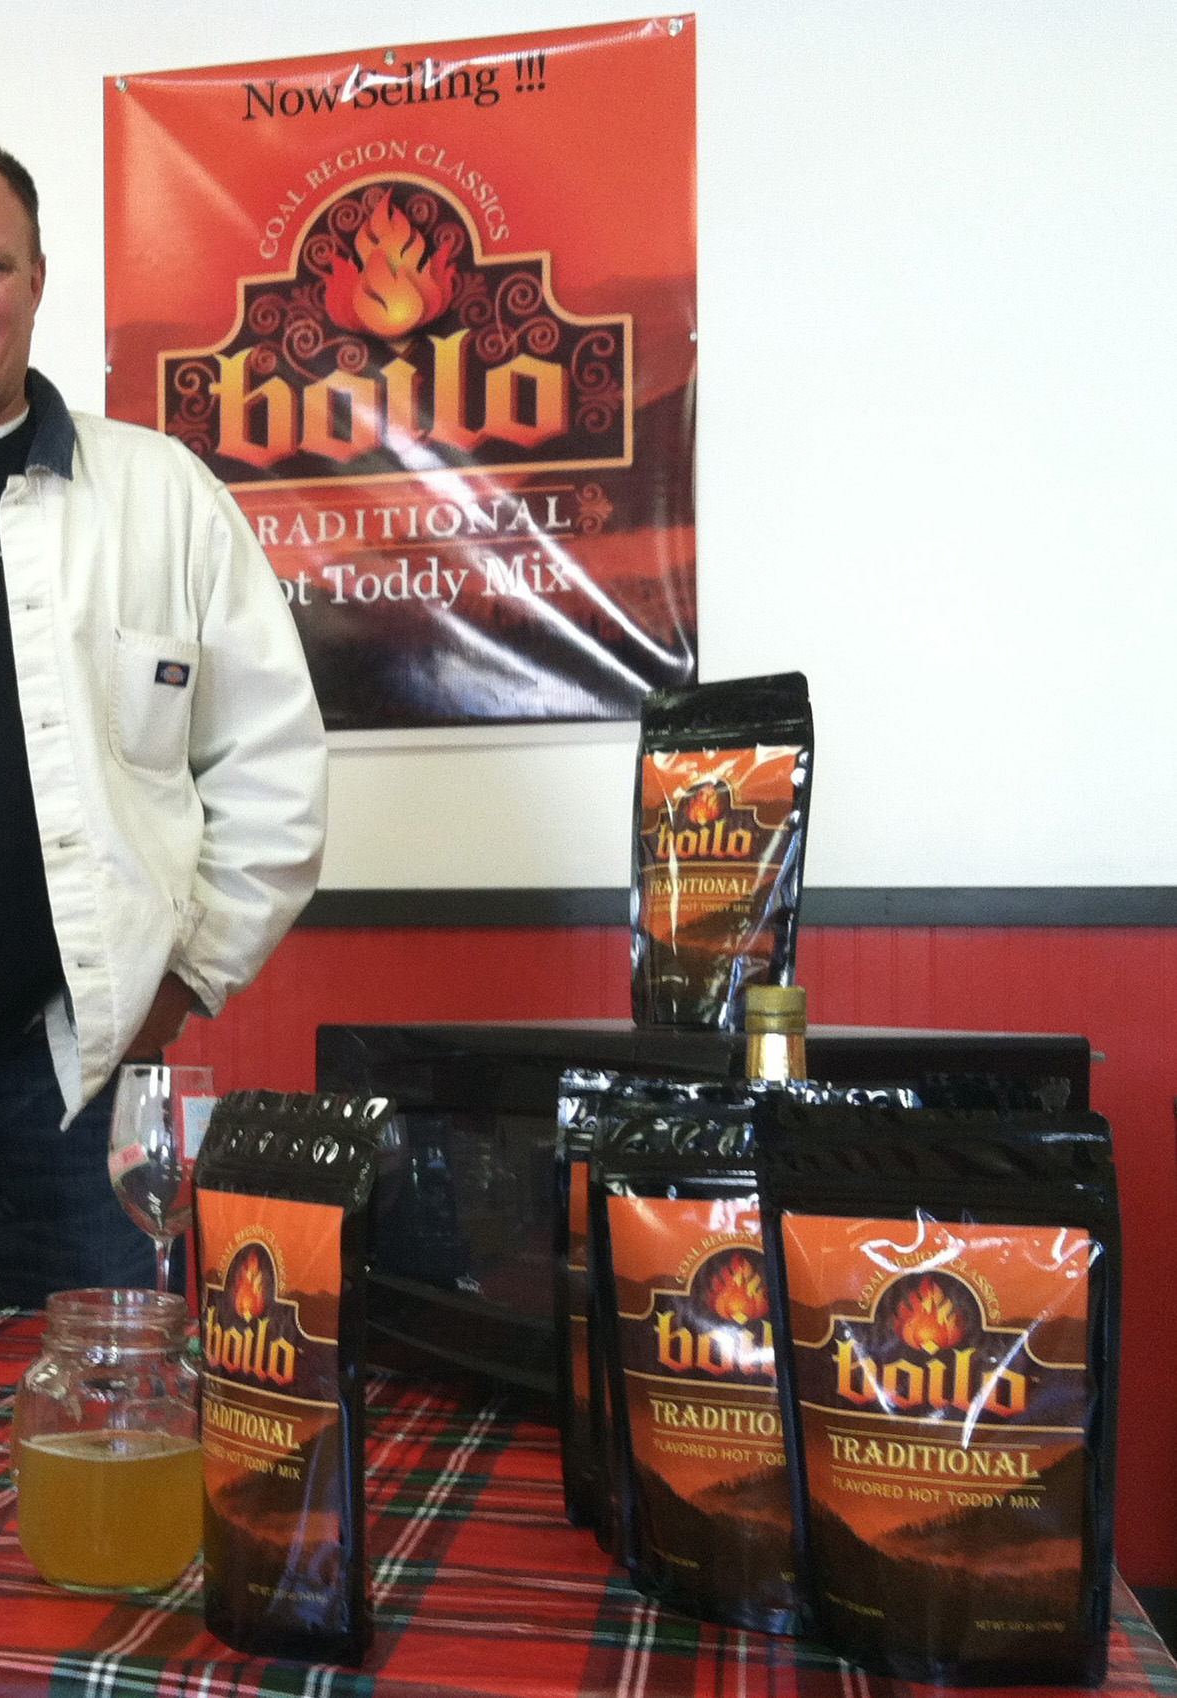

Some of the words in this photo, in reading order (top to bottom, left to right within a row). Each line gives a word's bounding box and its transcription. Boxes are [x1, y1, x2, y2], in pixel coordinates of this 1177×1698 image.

[242, 80, 341, 121] Now
[259, 189, 307, 259] COAL
[305, 140, 409, 190] REGION
[414, 143, 510, 241] CLASSICS
[209, 328, 568, 467] boilo
[255, 494, 572, 548] RADITIONAL
[278, 569, 313, 606] ot
[323, 557, 470, 609] Toddy
[481, 550, 572, 597] Mix
[656, 818, 752, 859] boilo
[205, 1306, 296, 1386] boilo
[654, 1310, 776, 1379] boil
[832, 1338, 1026, 1418] boilo
[648, 1398, 784, 1437] TRADITIO
[722, 1447, 752, 1464] HOT
[827, 1433, 1041, 1478] TRADITIONAL
[832, 1475, 905, 1500] FLAVORED
[909, 1486, 943, 1503] HOT
[947, 1490, 1006, 1509] TODDY
[1009, 1494, 1042, 1510] MIX
